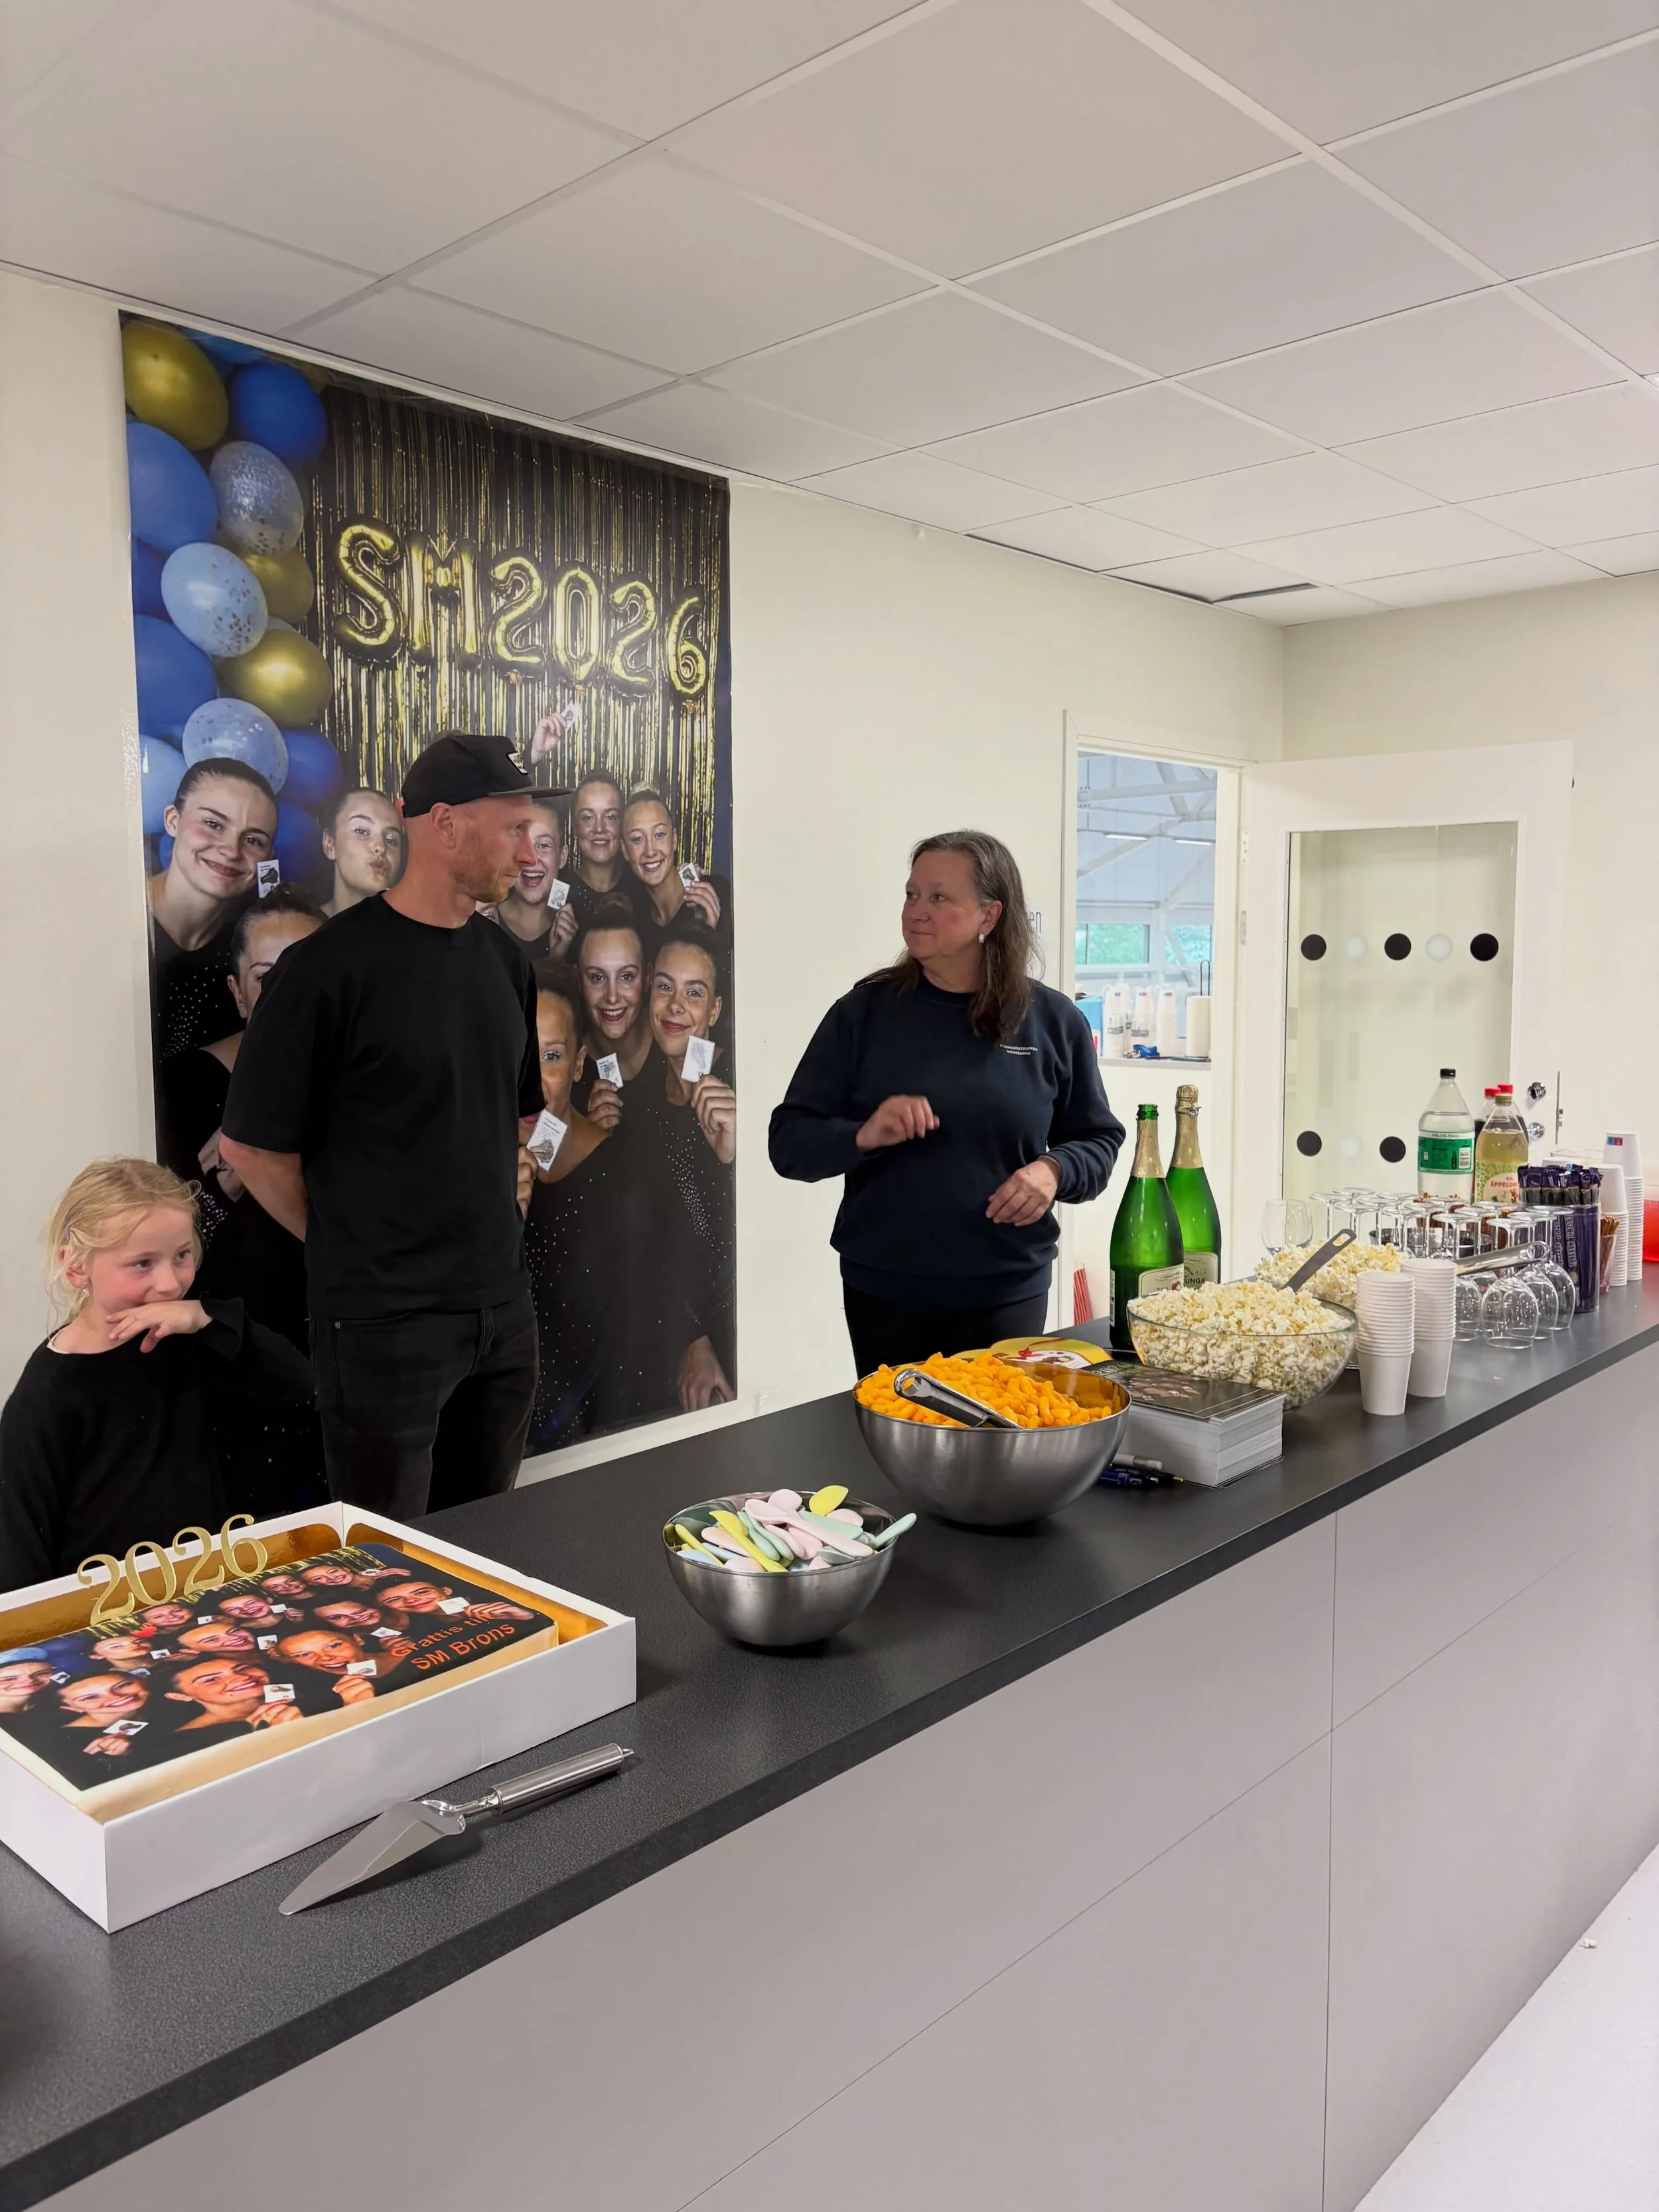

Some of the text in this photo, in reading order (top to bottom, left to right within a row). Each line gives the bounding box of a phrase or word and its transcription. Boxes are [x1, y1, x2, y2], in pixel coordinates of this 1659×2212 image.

[76, 1514, 268, 1626] 2026
[390, 1626, 463, 1657] Grattis
[411, 1624, 515, 1670] SM Brons
